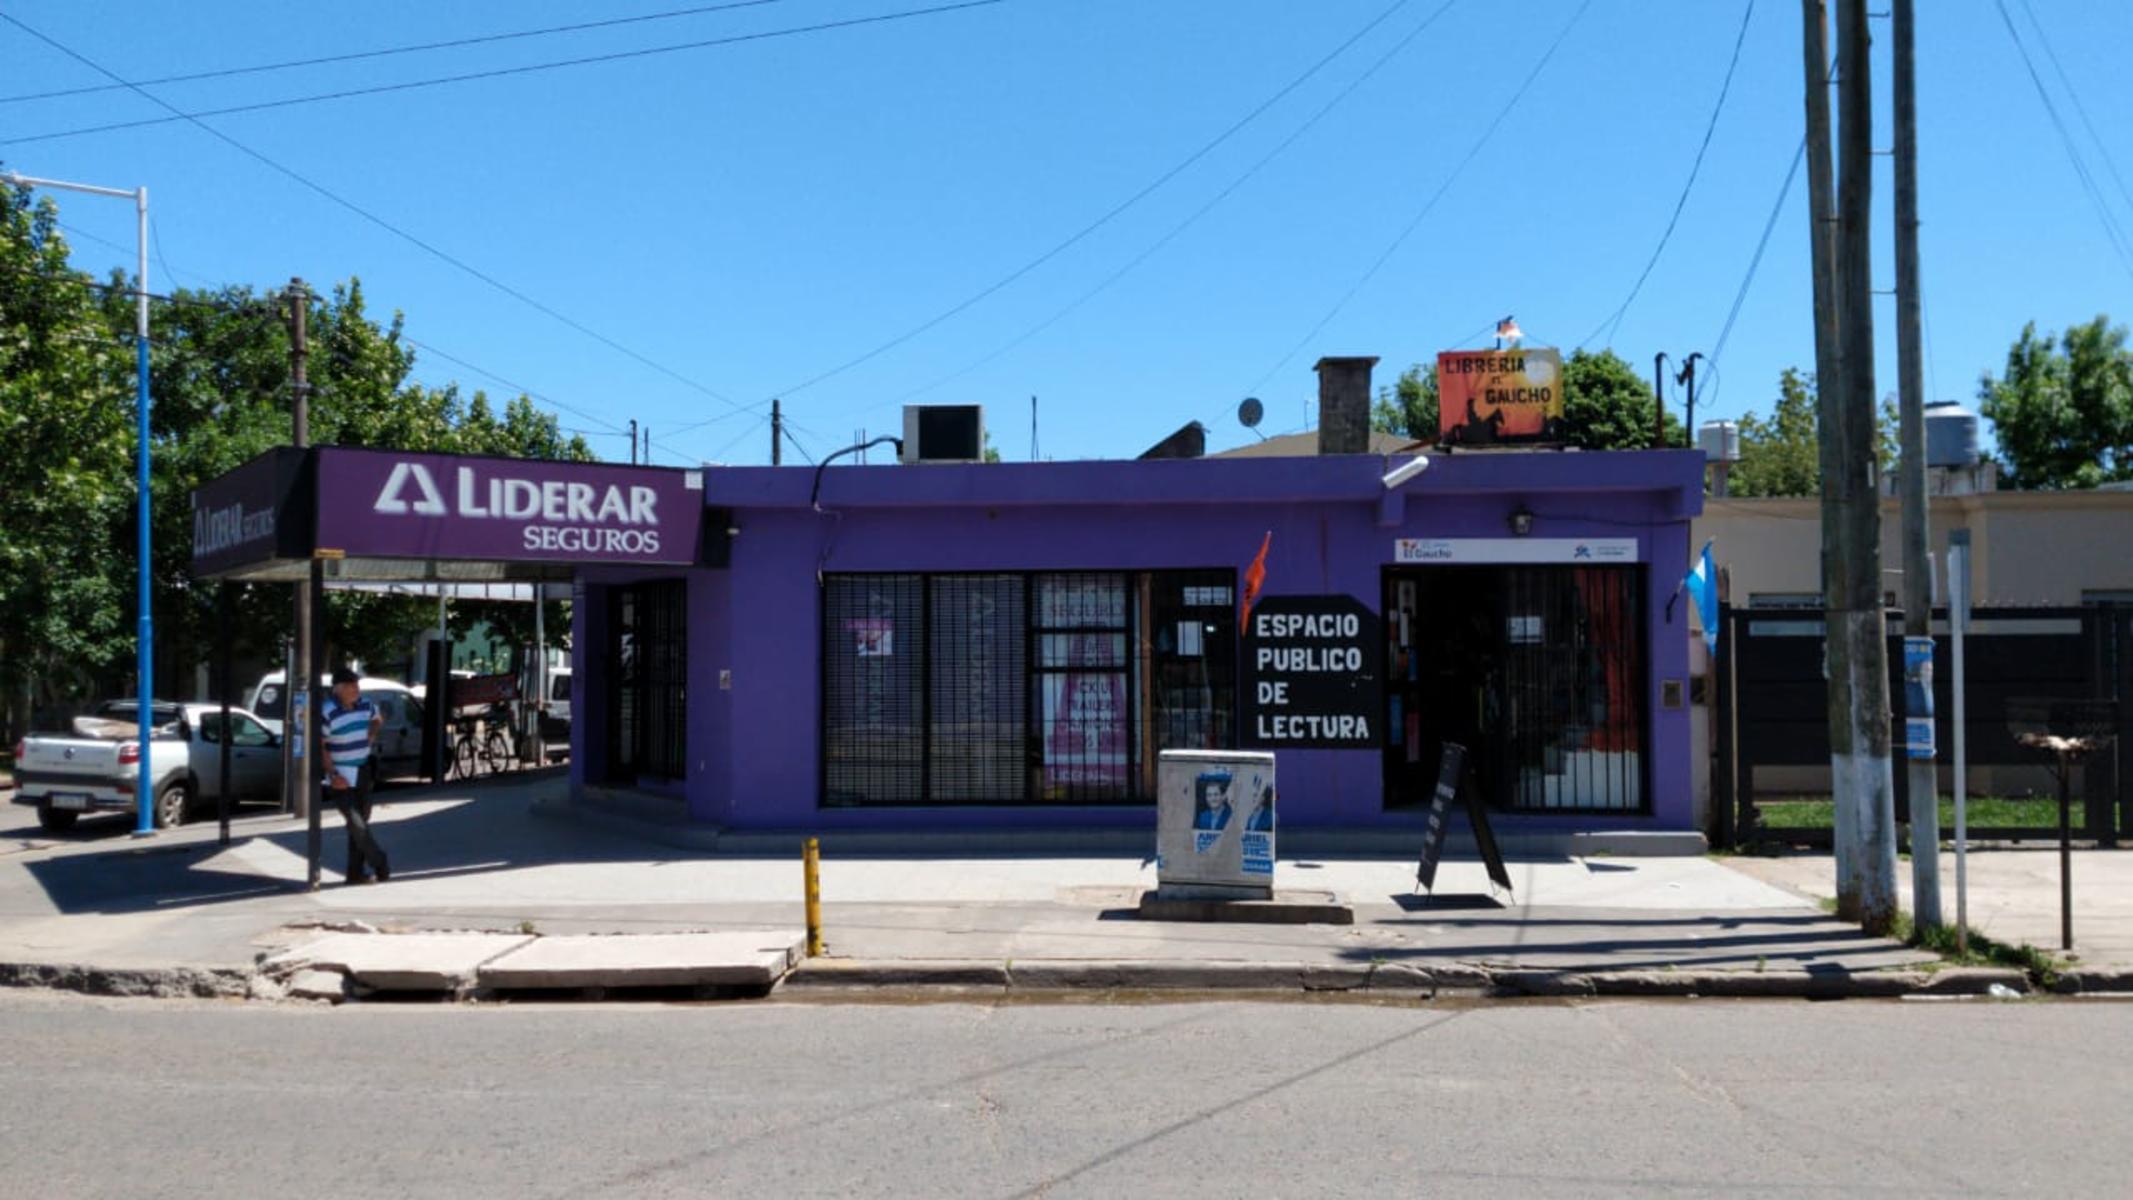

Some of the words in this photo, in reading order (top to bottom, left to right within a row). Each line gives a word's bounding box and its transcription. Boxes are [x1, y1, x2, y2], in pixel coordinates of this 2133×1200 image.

[1445, 357, 1526, 374] LIBRERIA
[1485, 387, 1552, 404] GAUCHO
[458, 468, 659, 524] LIDERAR
[523, 525, 660, 554] SEGUROS
[1256, 613, 1359, 638] ESPACIO
[1257, 647, 1362, 672] PUBLICO
[1257, 681, 1290, 705] DE
[1257, 714, 1370, 739] LECTURA
